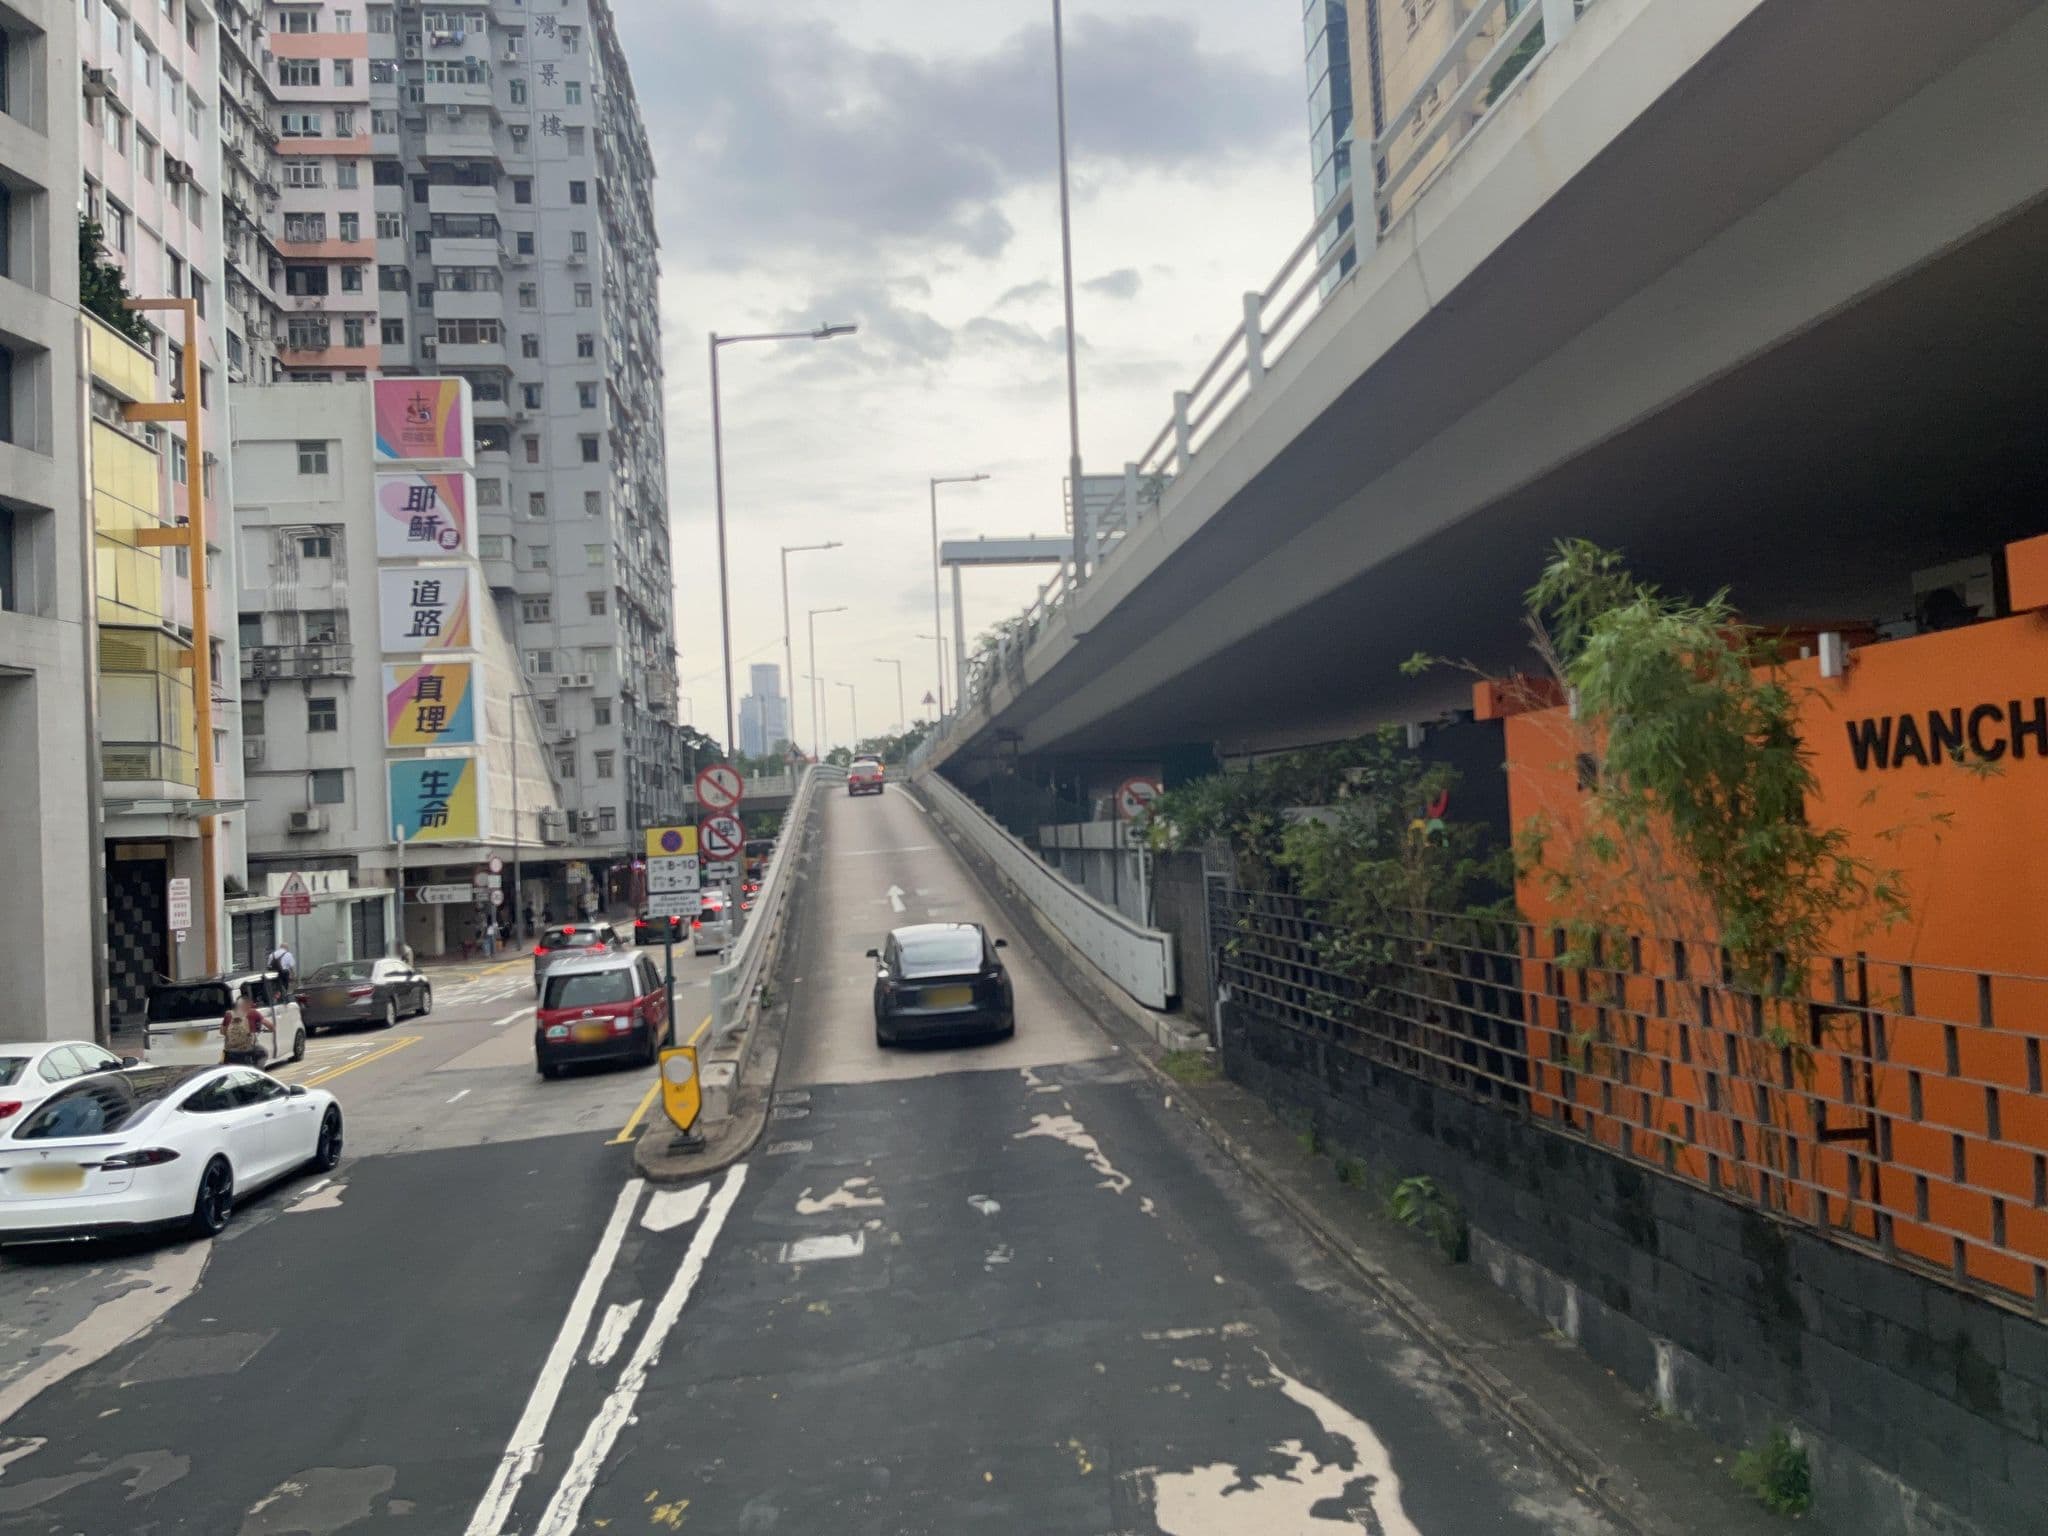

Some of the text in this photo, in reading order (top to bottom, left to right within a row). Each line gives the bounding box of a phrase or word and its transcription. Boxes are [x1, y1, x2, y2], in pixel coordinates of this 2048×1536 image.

[404, 580, 447, 637] 道路
[410, 676, 453, 733] 真理
[1846, 697, 2048, 770] WANCH
[416, 770, 452, 828] 生命
